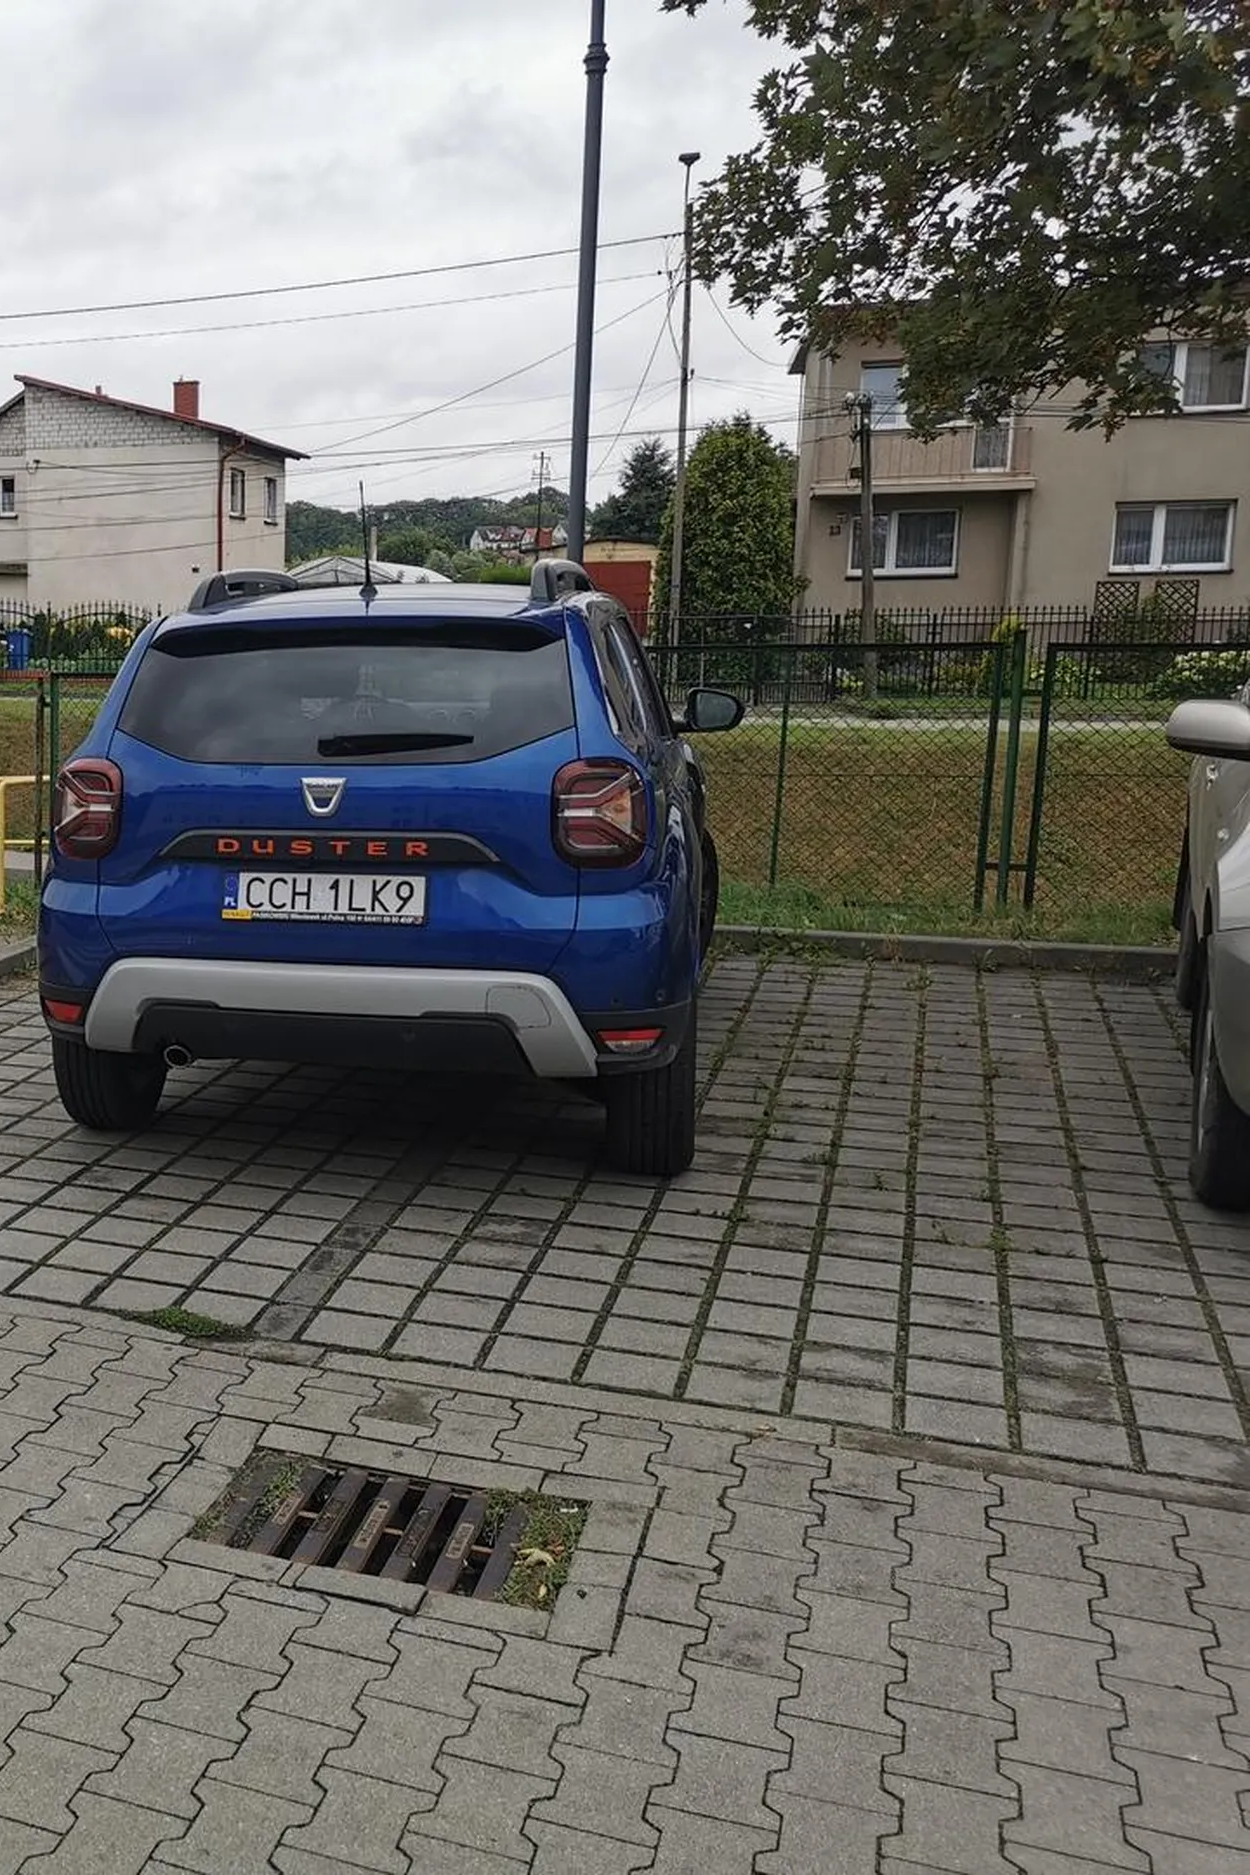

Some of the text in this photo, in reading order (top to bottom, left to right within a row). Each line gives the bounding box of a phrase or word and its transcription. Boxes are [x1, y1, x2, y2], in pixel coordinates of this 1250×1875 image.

[217, 839, 429, 856] DUSTER
[224, 896, 237, 907] PL
[245, 876, 416, 913] CCH 1LK9
